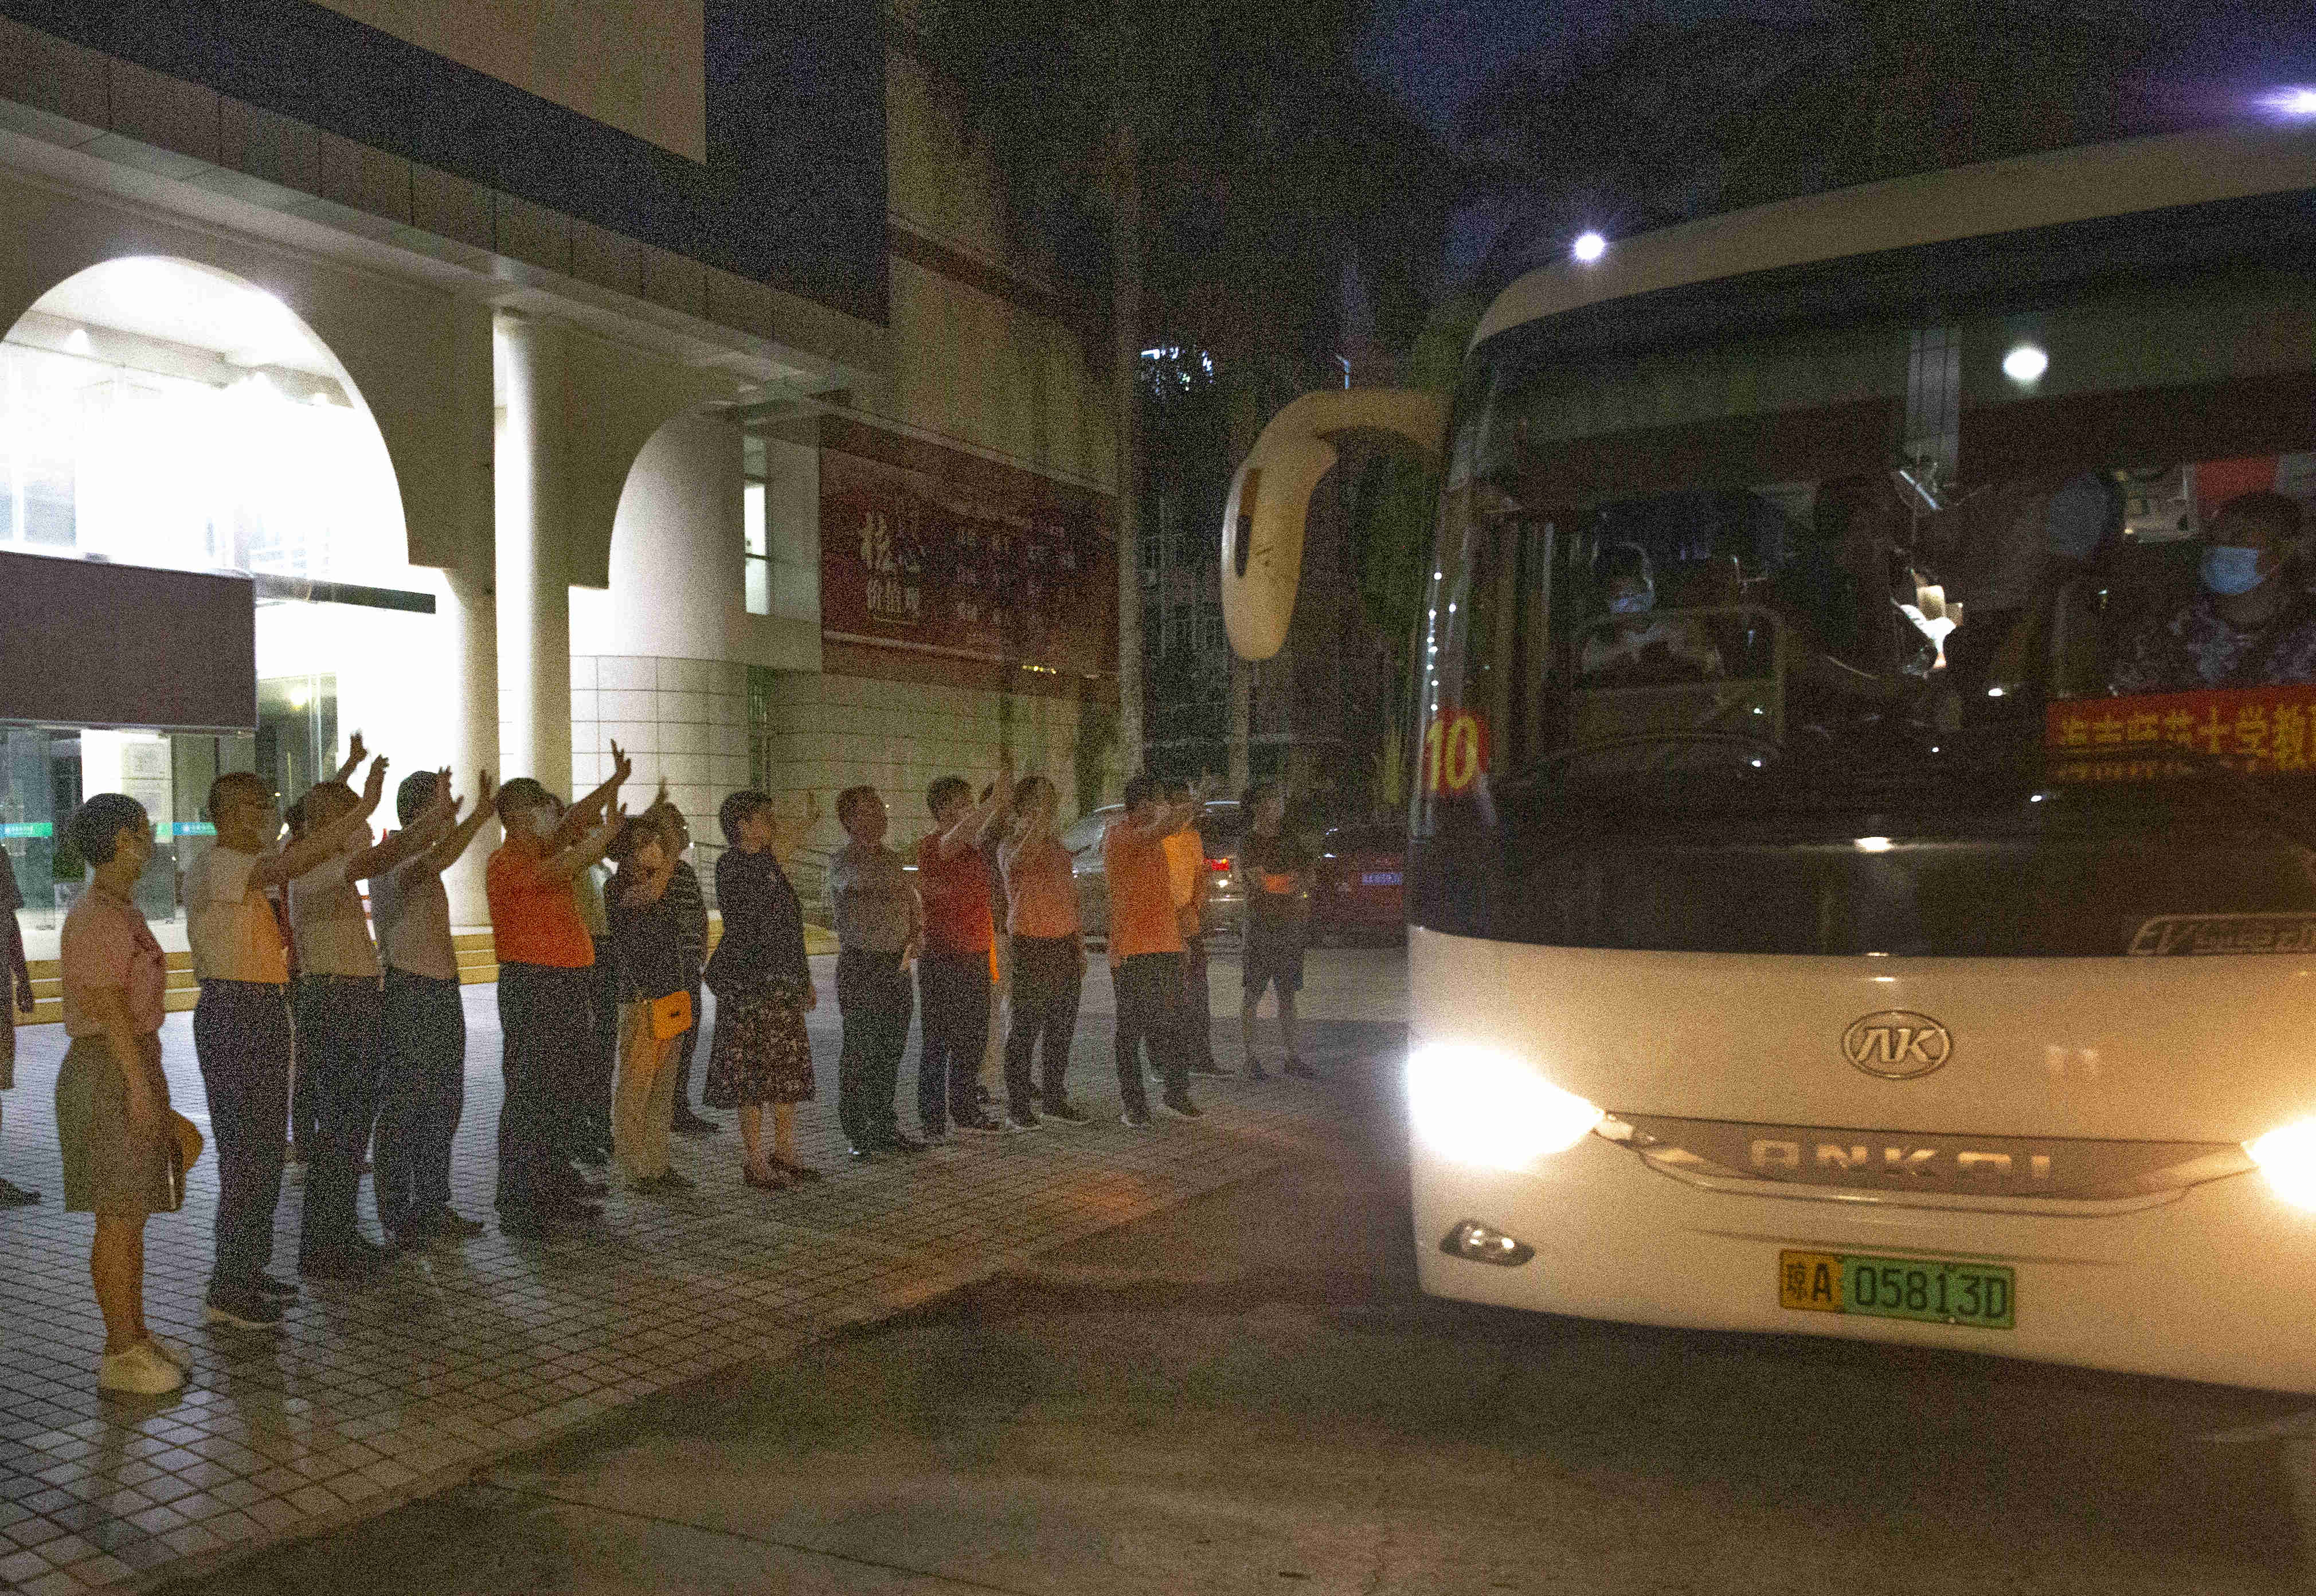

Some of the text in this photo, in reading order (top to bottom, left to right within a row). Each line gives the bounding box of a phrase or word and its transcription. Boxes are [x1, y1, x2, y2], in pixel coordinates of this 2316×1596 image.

[1426, 716, 1478, 792] 10
[1748, 1139, 2052, 1180] ANKAI
[1855, 1266, 2008, 1319] 05813D
